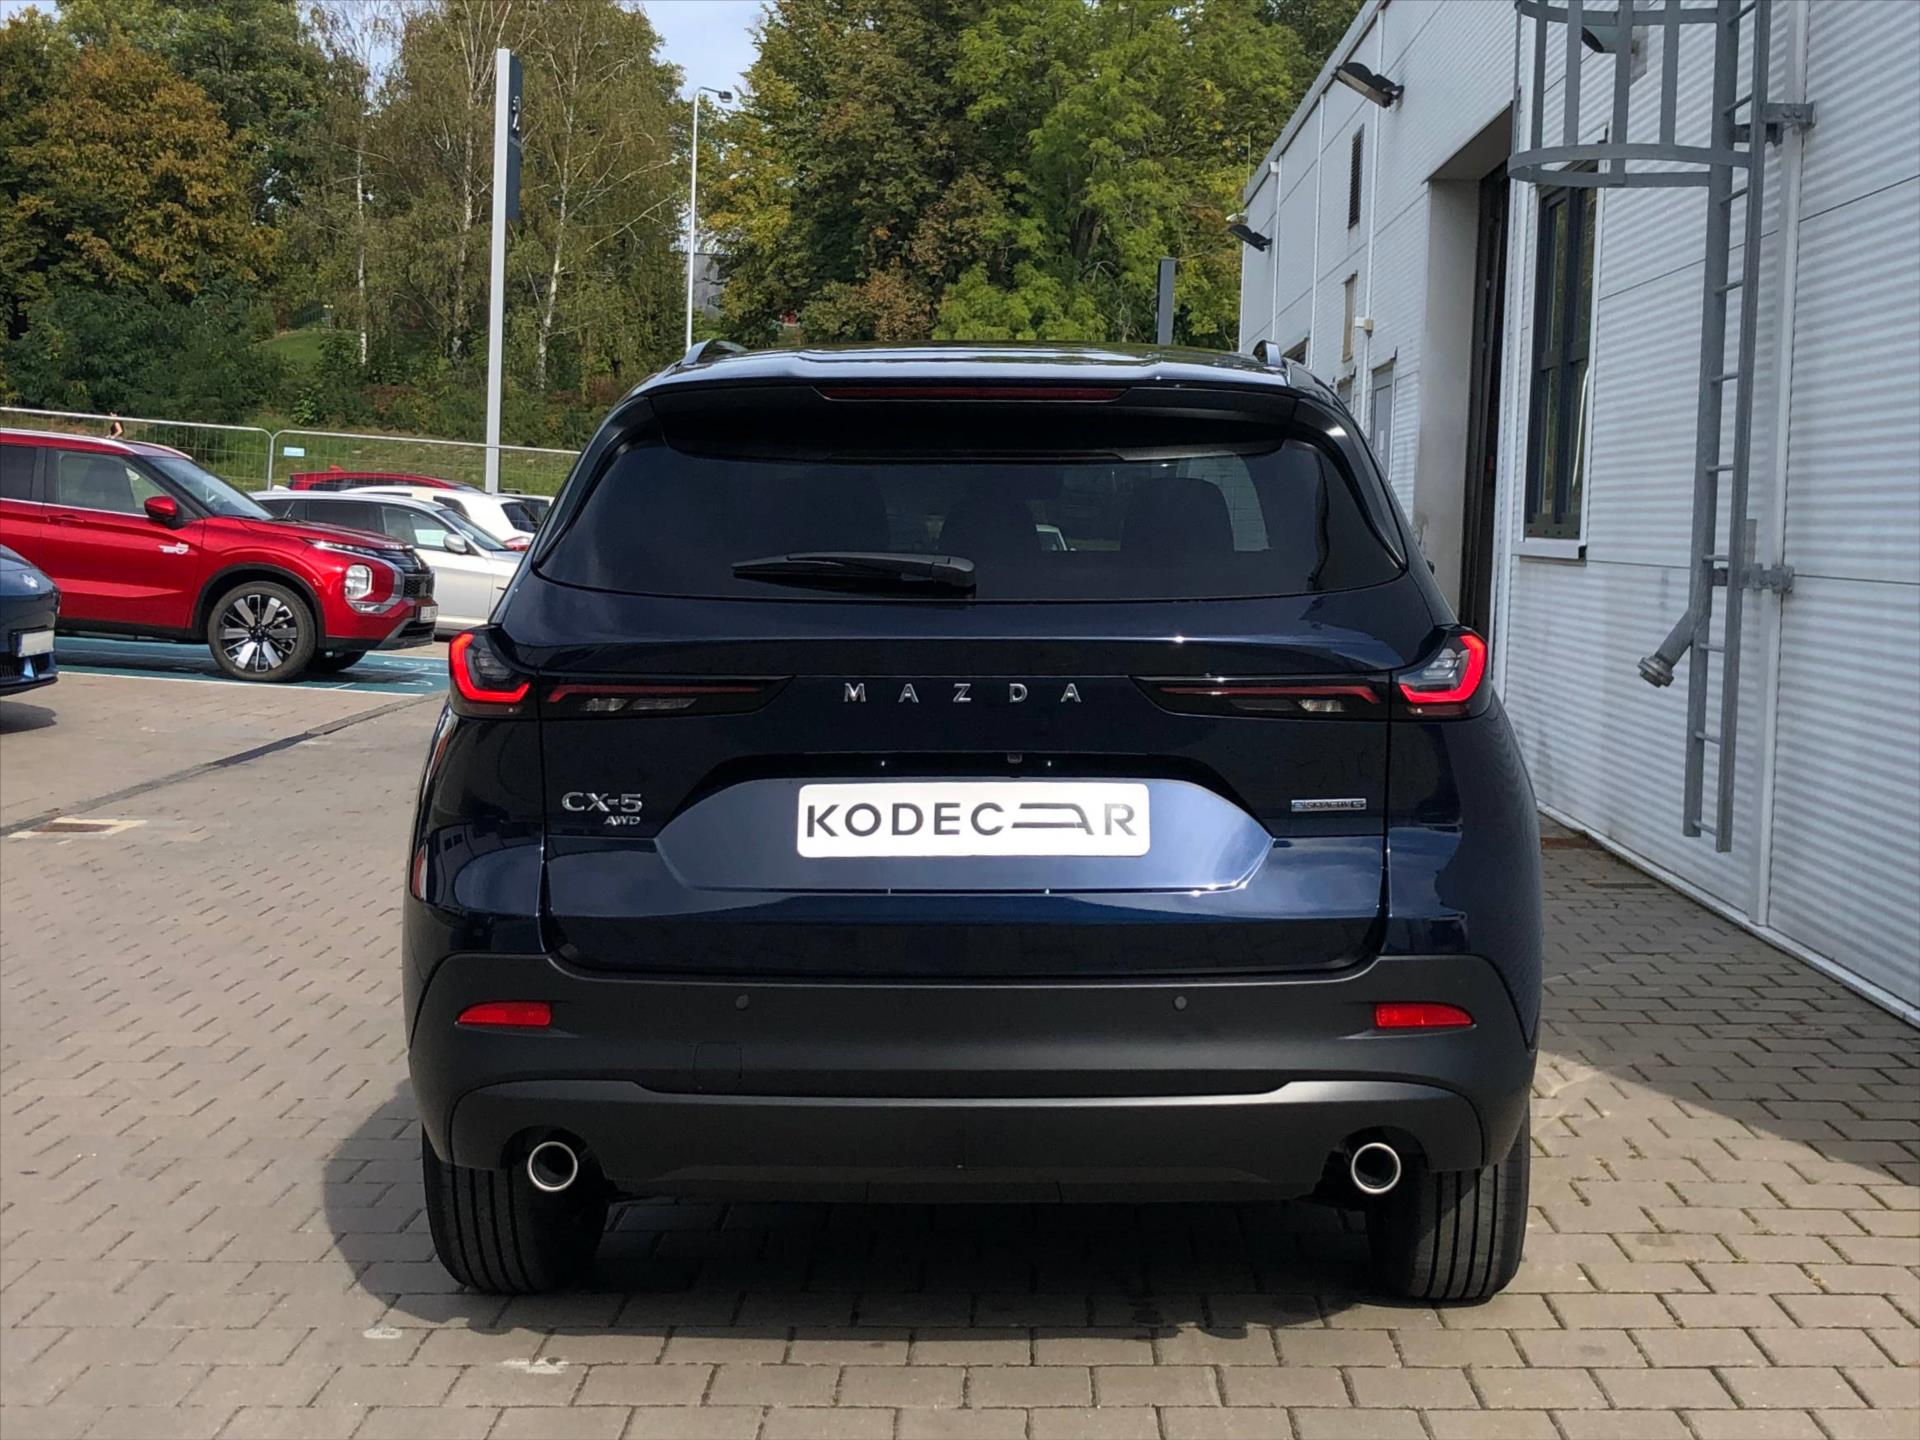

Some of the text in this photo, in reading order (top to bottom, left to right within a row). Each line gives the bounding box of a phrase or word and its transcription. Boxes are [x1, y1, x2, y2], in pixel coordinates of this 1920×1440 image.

[843, 682, 1082, 703] MAZDA
[561, 791, 643, 813] CX-5
[604, 815, 641, 826] AWD
[806, 801, 1137, 838] KODECAR
